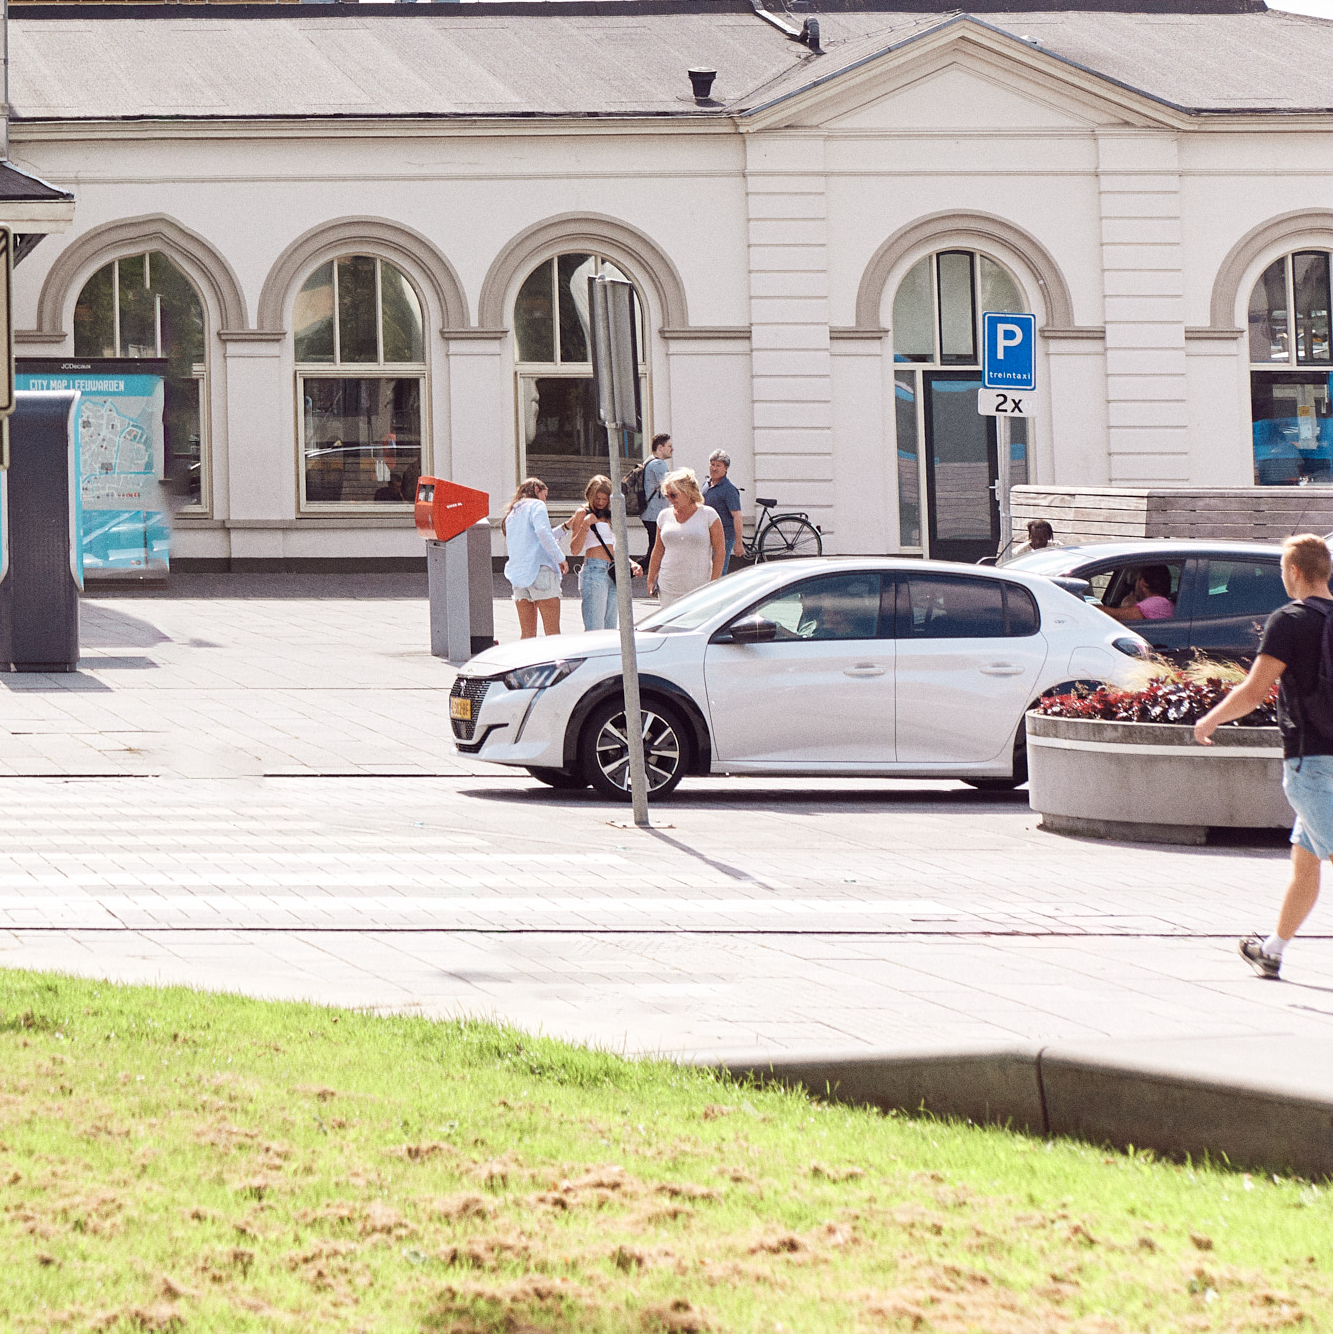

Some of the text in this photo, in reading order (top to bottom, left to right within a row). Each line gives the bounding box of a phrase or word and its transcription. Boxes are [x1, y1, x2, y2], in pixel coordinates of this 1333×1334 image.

[997, 323, 1023, 360] P
[989, 371, 1031, 380] treintaxi
[29, 380, 125, 392] CITY MAP LEEUWARDEN
[995, 394, 1023, 413] 2x
